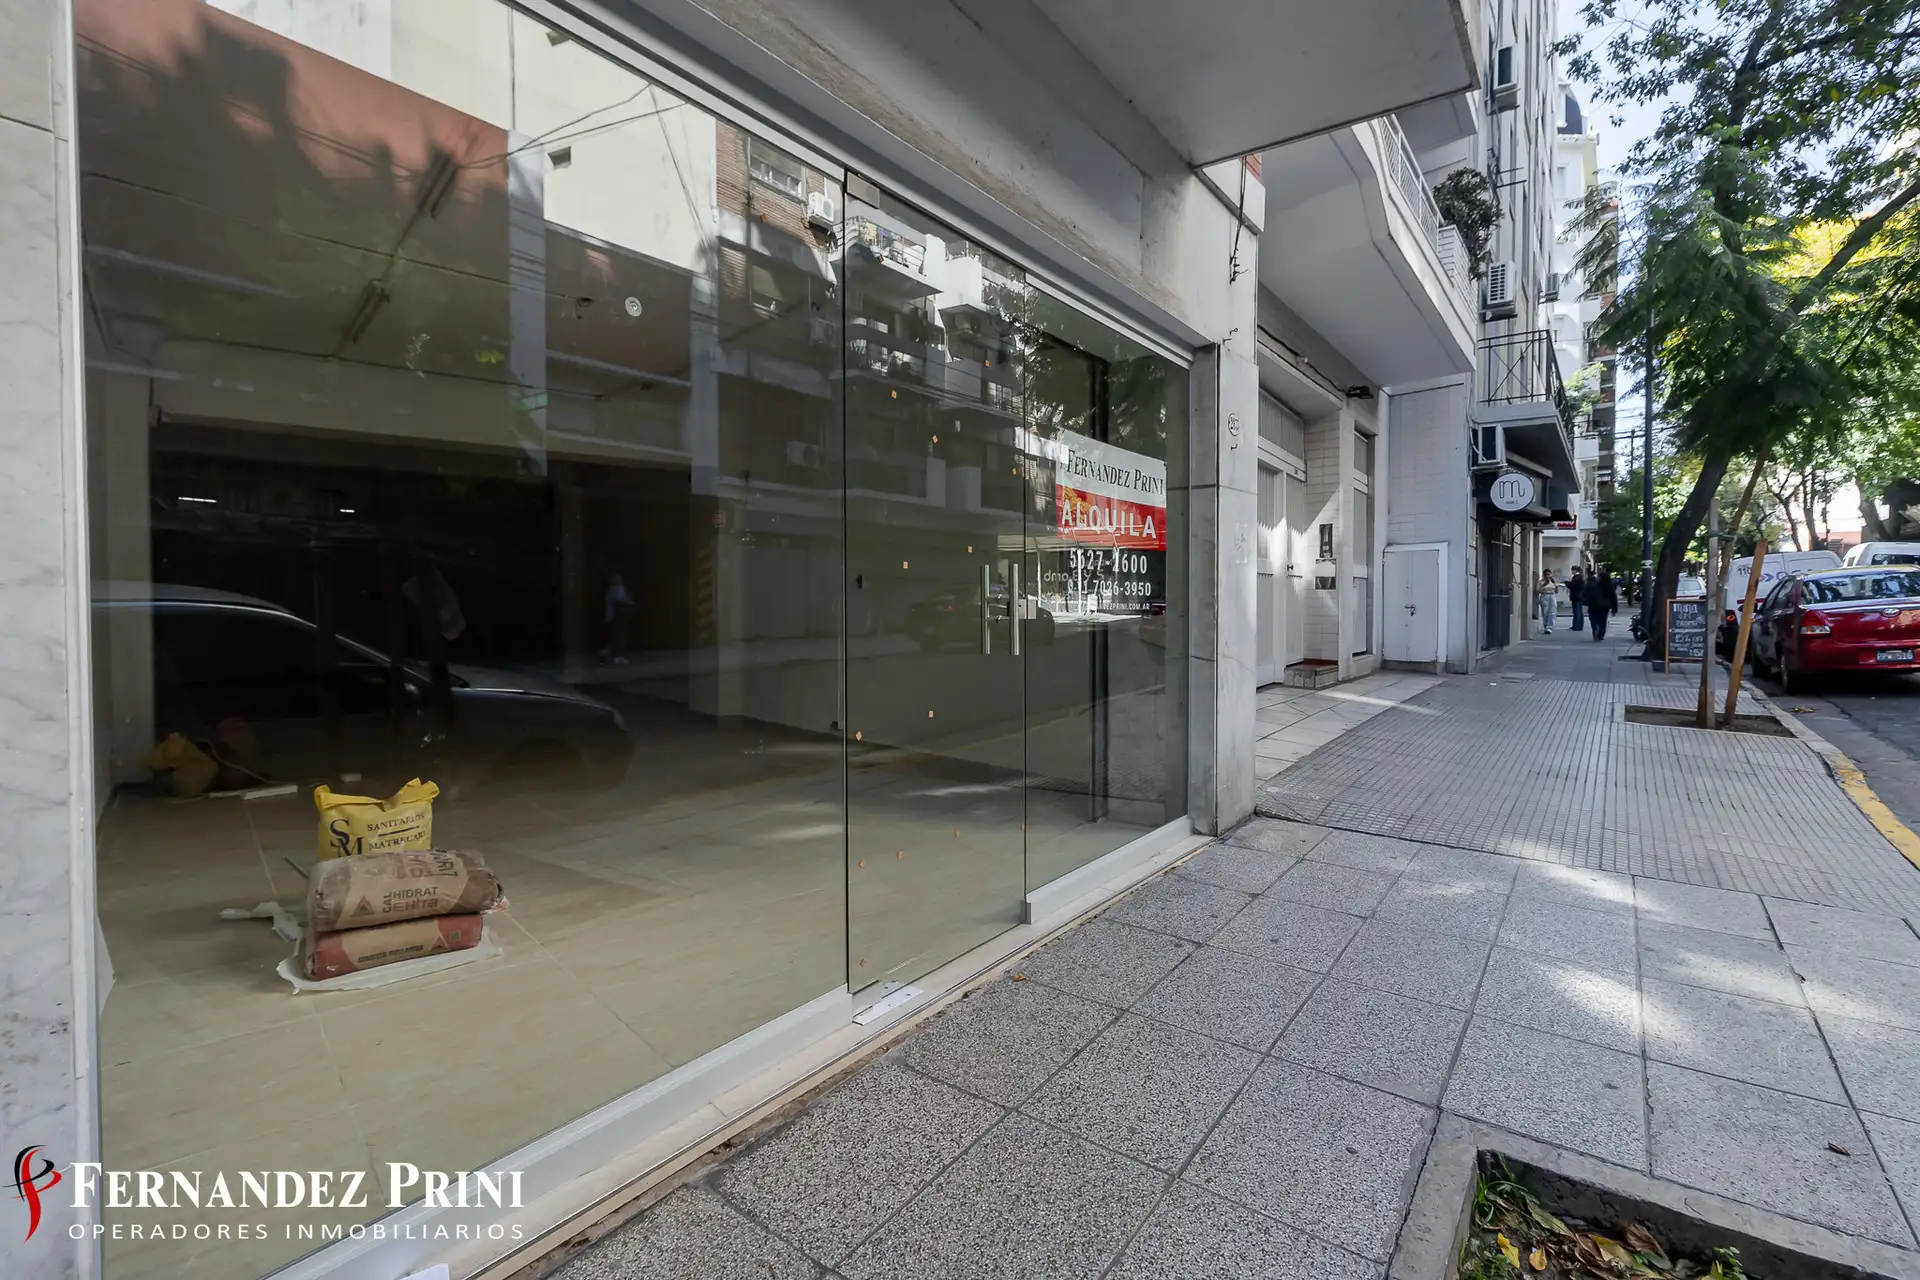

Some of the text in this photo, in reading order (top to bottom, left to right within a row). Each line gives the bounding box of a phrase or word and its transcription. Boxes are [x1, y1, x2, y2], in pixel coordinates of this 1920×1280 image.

[1067, 449, 1163, 495] FERNANDEZ PRINI
[1062, 499, 1157, 538] ALQUILA
